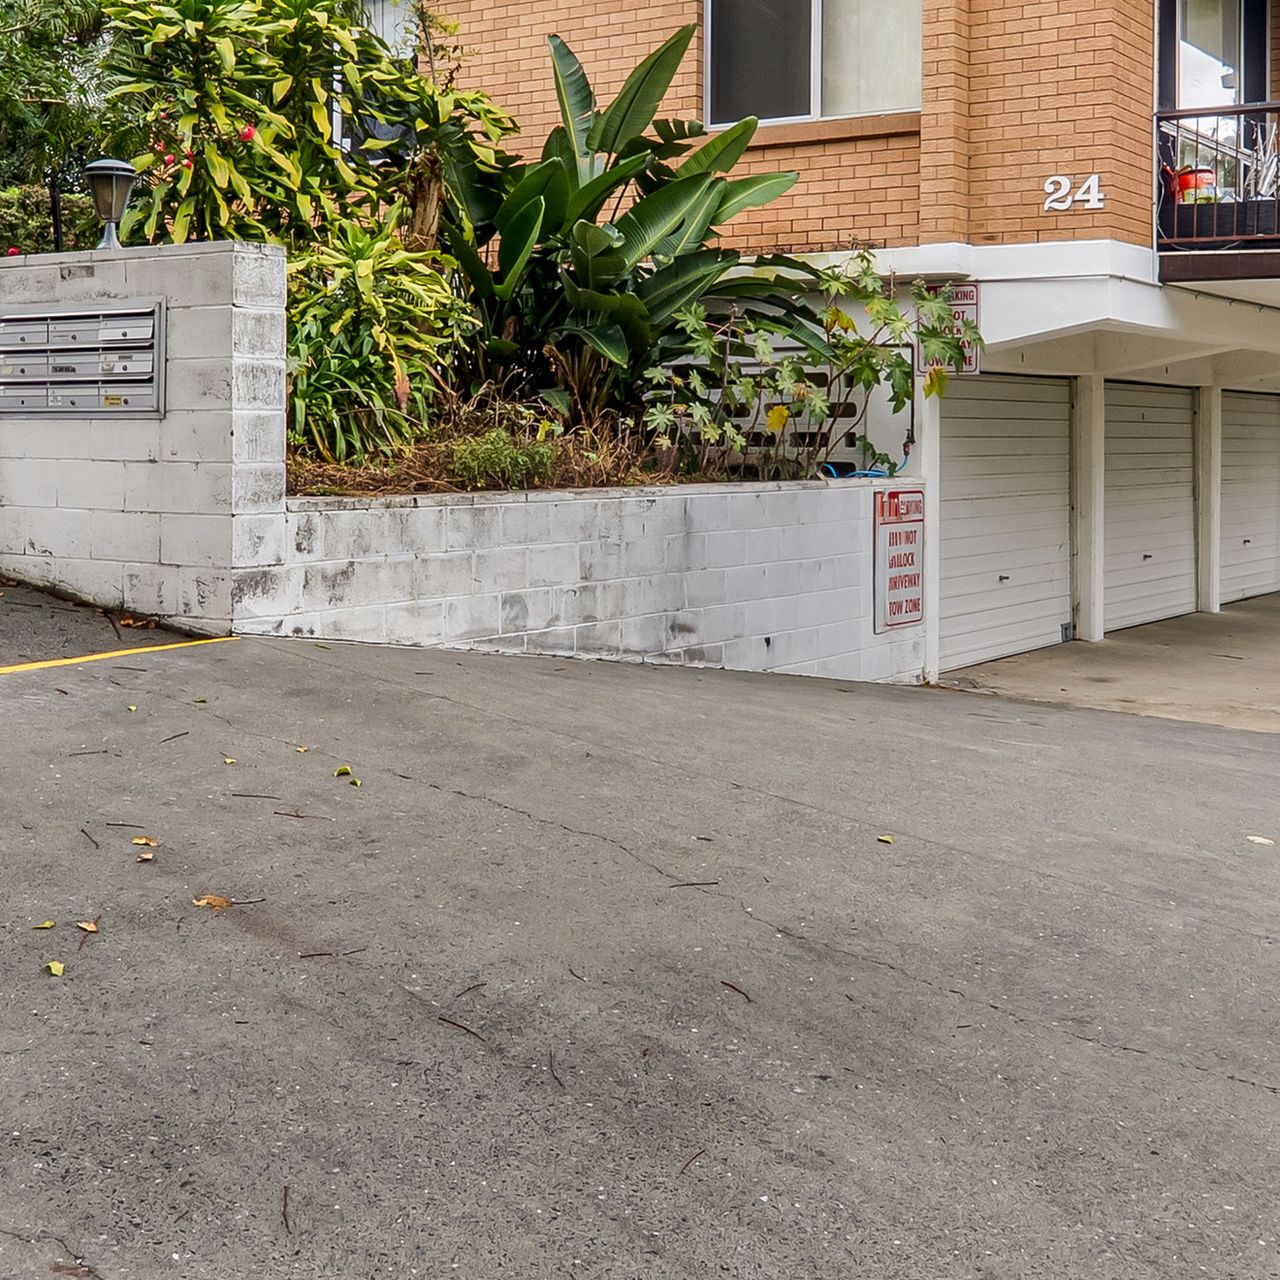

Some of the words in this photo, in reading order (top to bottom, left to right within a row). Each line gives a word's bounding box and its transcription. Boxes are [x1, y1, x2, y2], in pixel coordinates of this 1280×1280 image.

[1043, 174, 1105, 212] 24
[952, 310, 967, 321] OT
[889, 600, 904, 616] TOW
[904, 597, 921, 614] ZONE
